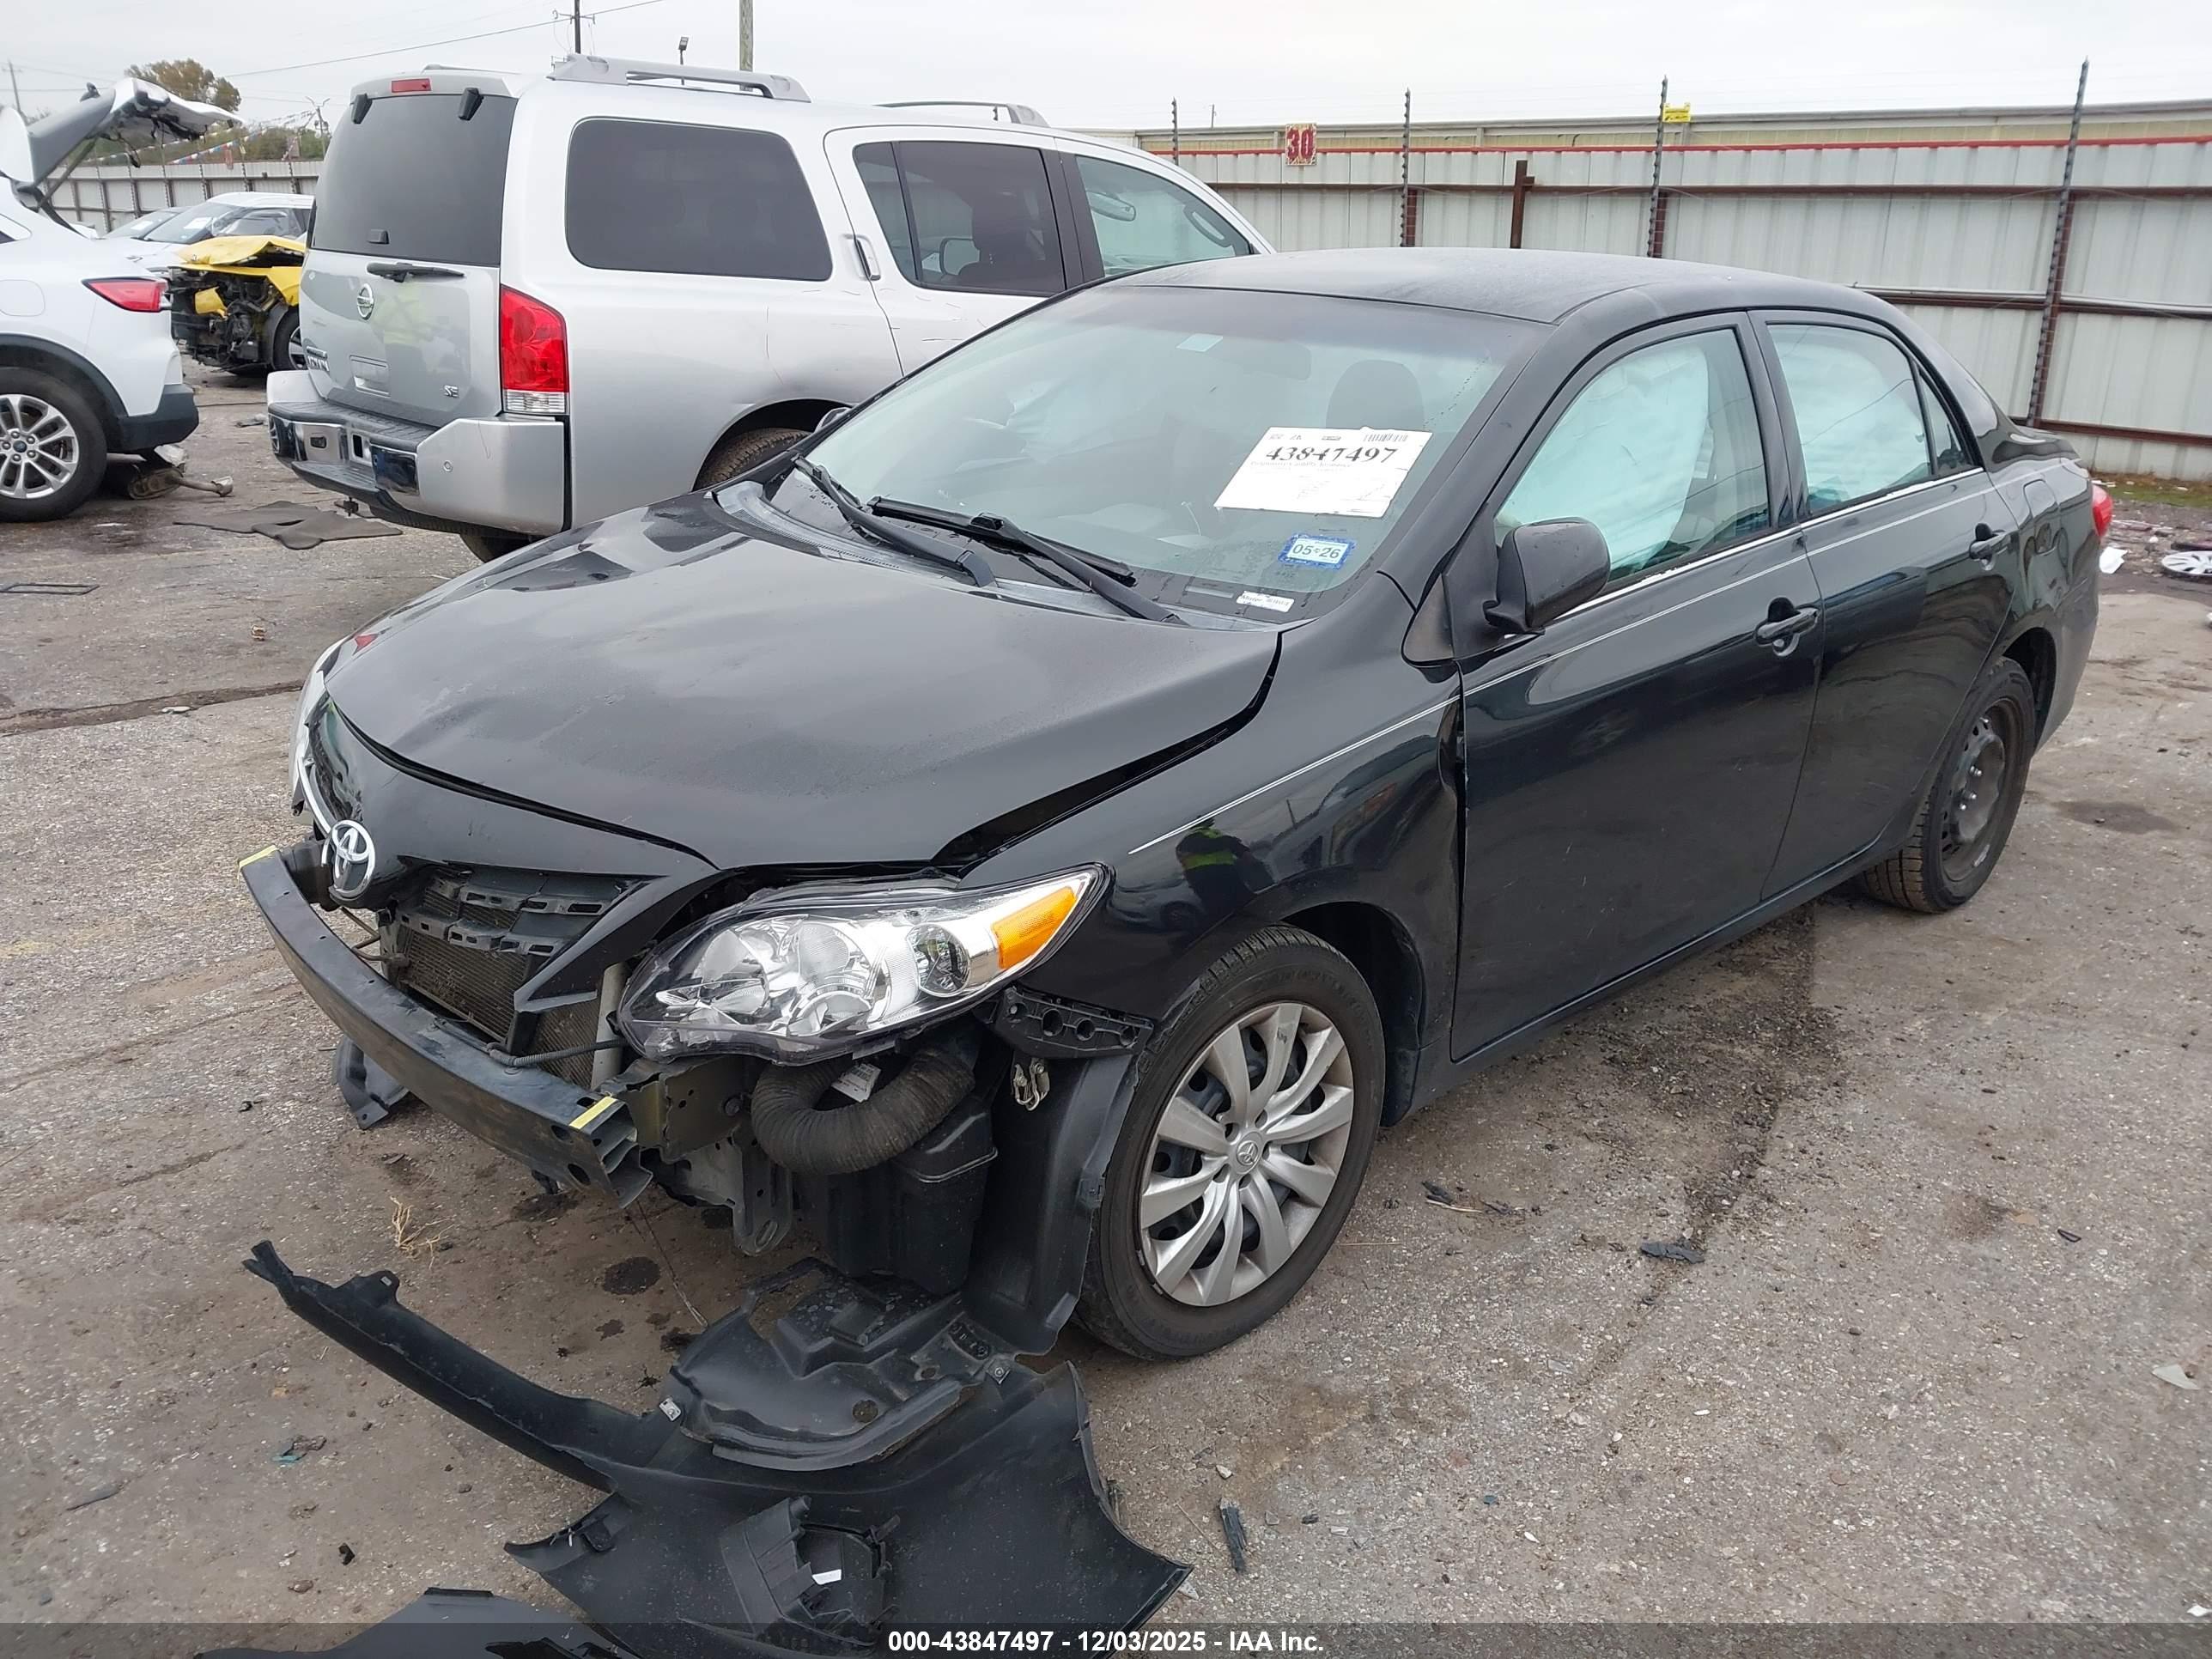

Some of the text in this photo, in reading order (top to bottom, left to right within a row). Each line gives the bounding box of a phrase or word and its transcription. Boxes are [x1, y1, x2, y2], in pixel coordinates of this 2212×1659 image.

[1286, 127, 1314, 160] 30
[443, 385, 459, 398] SE
[1266, 446, 1399, 464] 43847497
